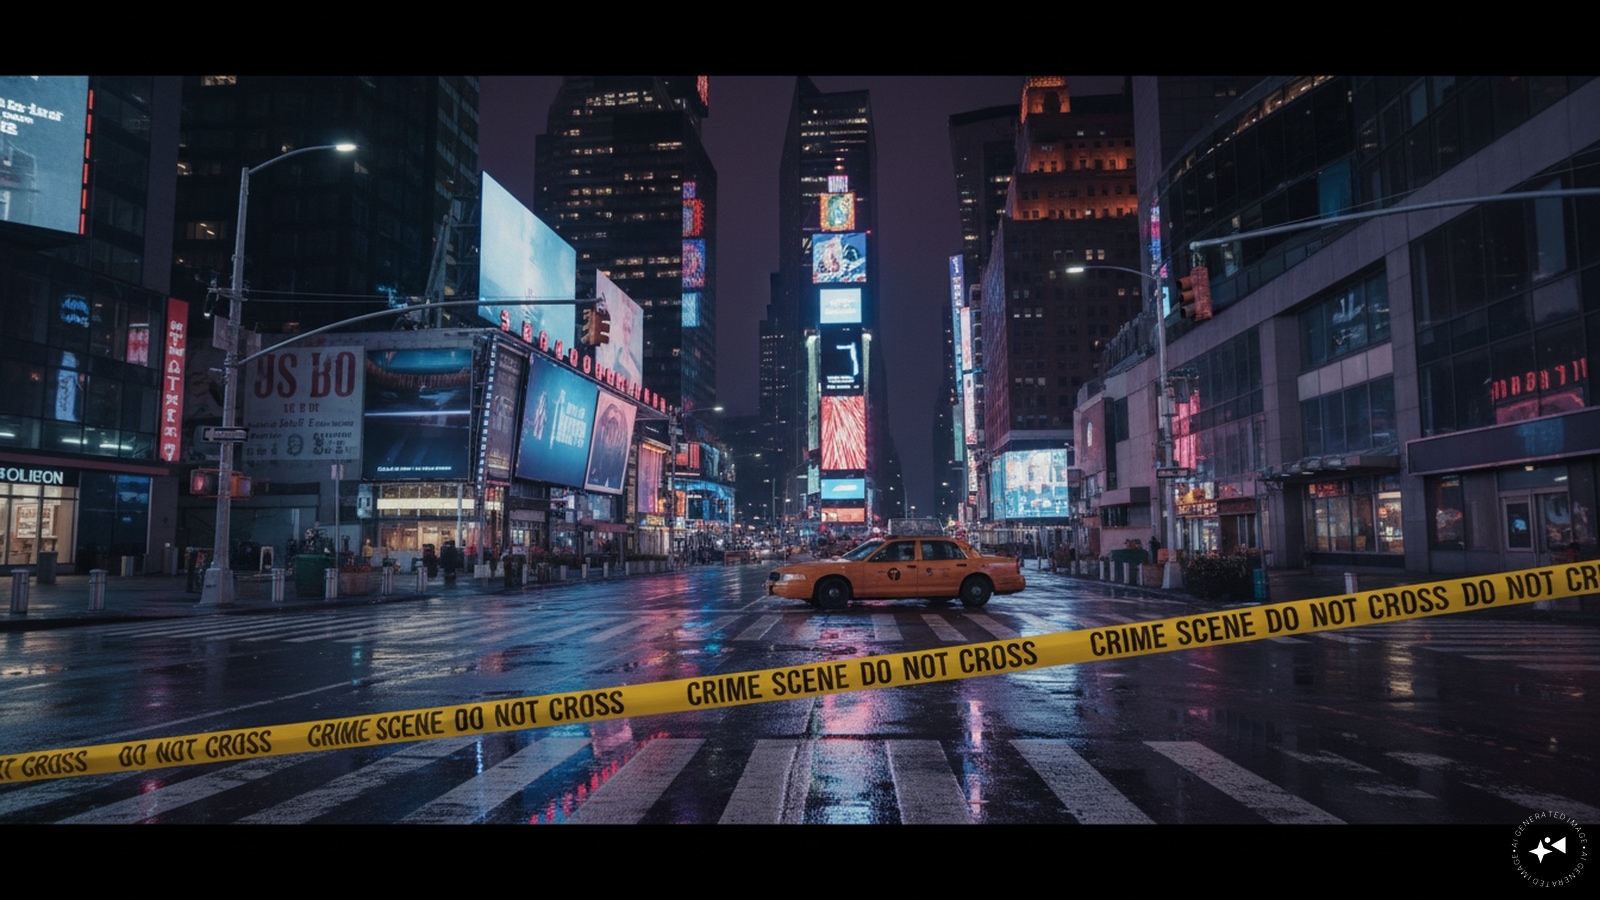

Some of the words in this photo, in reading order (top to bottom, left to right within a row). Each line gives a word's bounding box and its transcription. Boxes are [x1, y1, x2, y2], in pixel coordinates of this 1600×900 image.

[1091, 624, 1168, 656] CRIME
[1176, 611, 1256, 645] SCENE
[1265, 606, 1300, 633] DO
[1309, 597, 1357, 627] NOT
[1368, 585, 1450, 619] CROSS
[1460, 579, 1496, 606] DO
[1505, 570, 1554, 600] NOT
[1565, 564, 1600, 592] CR
[687, 674, 763, 705] CRIME
[771, 664, 850, 696] SCENE
[860, 659, 892, 685] DO
[902, 651, 948, 680] NOT
[959, 640, 1038, 673] CROSS
[155, 738, 198, 763] NOT
[205, 730, 272, 758] CROSS
[307, 719, 371, 747] CRIME
[375, 711, 445, 740] SCENE
[494, 700, 539, 727] NOT
[549, 690, 625, 721] CROSS
